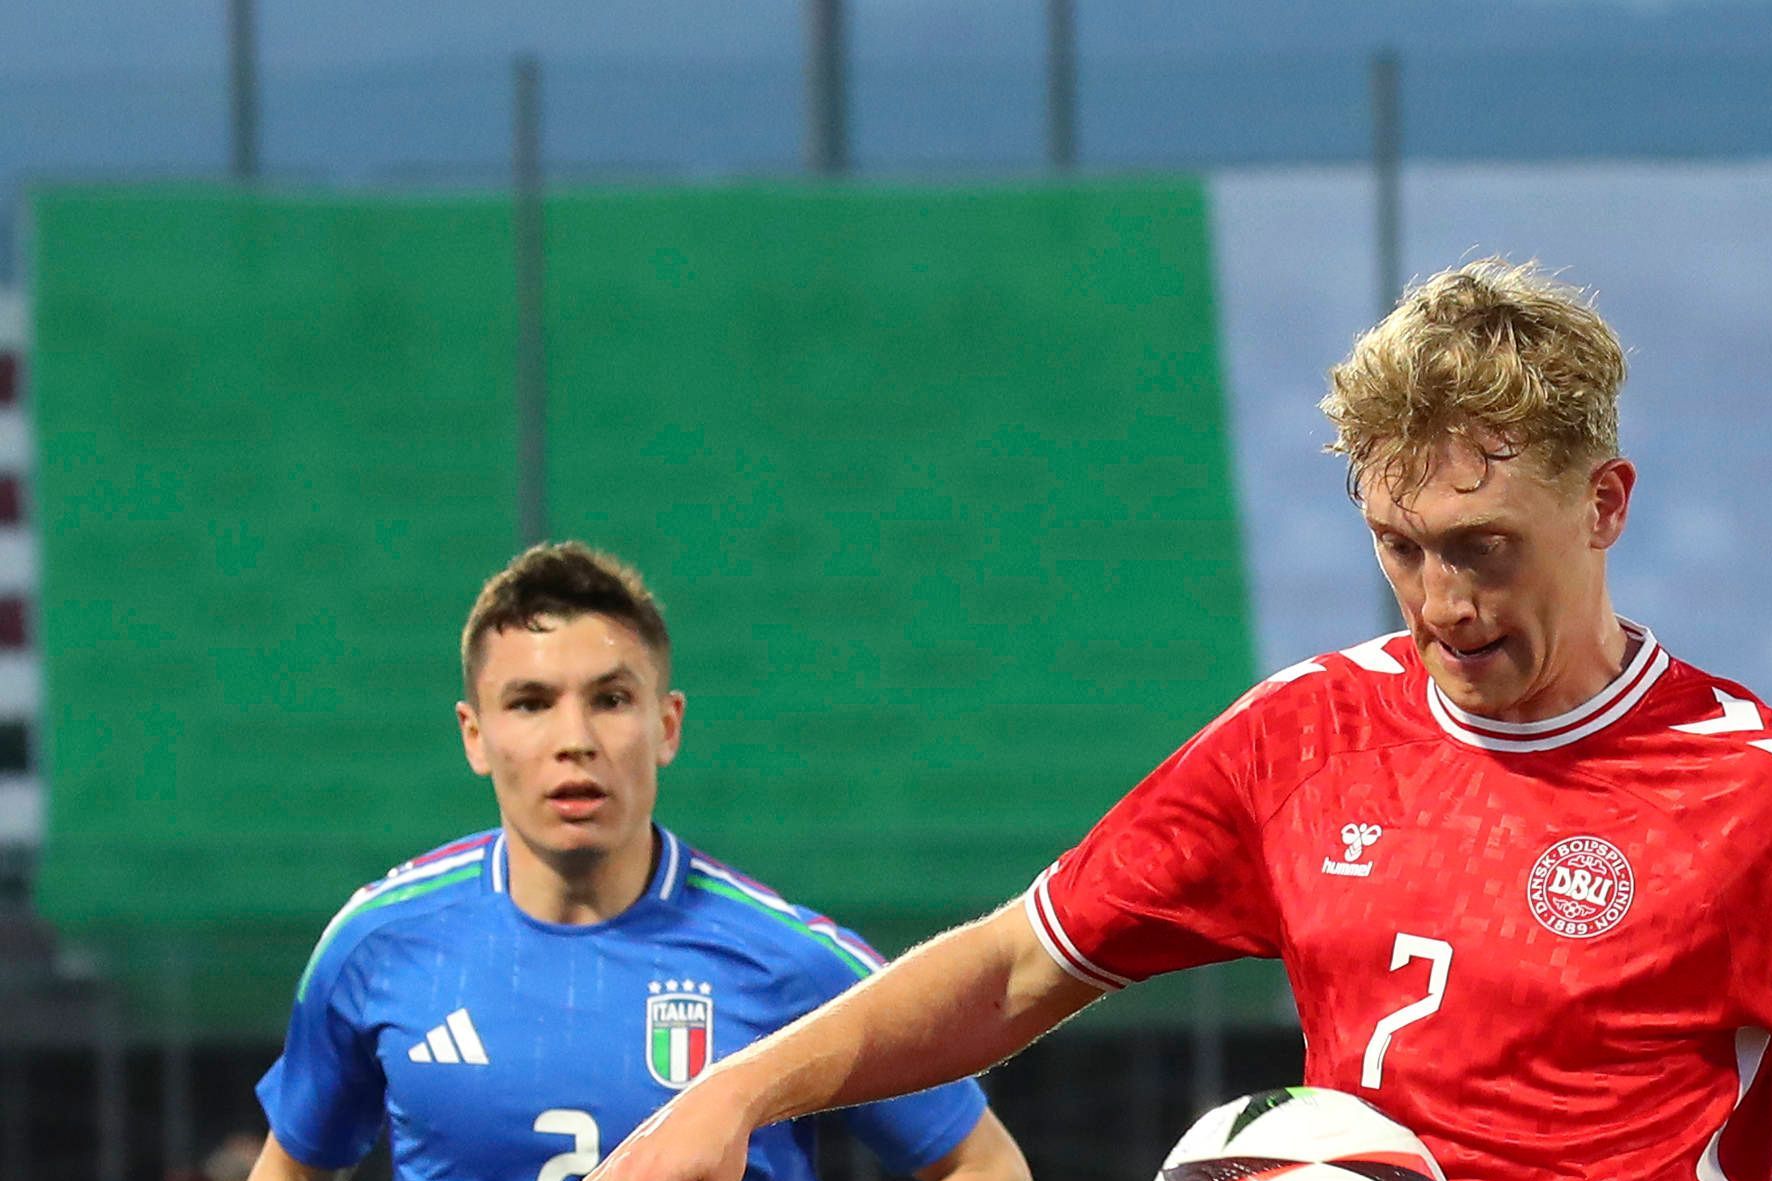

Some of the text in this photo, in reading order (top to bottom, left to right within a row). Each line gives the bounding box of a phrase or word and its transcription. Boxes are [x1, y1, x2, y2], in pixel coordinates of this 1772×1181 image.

[1321, 856, 1374, 877] hummel
[1531, 855, 1556, 914] DANSK
[1594, 880, 1630, 930] UNION
[1548, 866, 1614, 907] DBU
[1547, 915, 1588, 935] 1889
[652, 1001, 706, 1021] ITALIA
[1361, 932, 1454, 1090] 7
